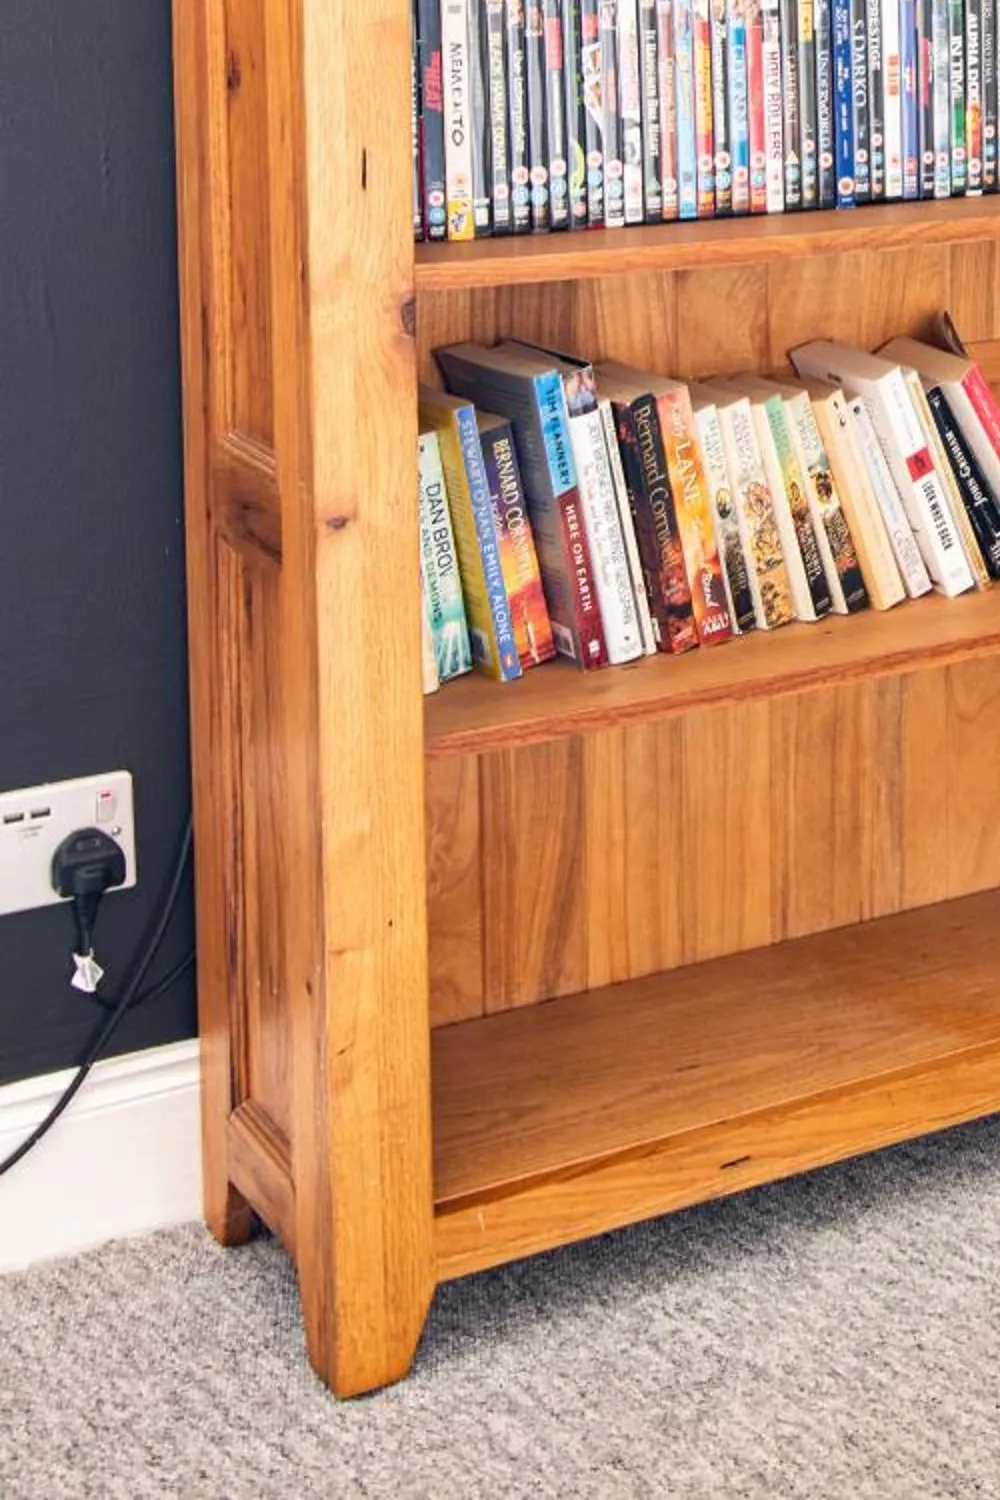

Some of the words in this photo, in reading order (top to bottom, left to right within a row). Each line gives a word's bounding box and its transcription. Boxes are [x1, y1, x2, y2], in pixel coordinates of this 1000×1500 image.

[968, 12, 979, 68] ALPHA
[449, 41, 464, 147] MEMENTO
[766, 51, 778, 88] HOLY
[818, 49, 830, 149] UNDERWORLD
[767, 92, 780, 160] ROLLERS
[492, 438, 520, 506] BERNARD
[549, 416, 572, 486] FLANNERY
[945, 430, 971, 479] GRISHAM
[425, 483, 446, 523] DAN
[633, 404, 665, 486] Bernard
[649, 486, 680, 567] Cornwell
[965, 477, 987, 507] JOHN
[564, 503, 580, 540] HERE
[571, 543, 586, 566] ON
[575, 567, 593, 613] EARTH
[491, 594, 511, 643] ALONE
